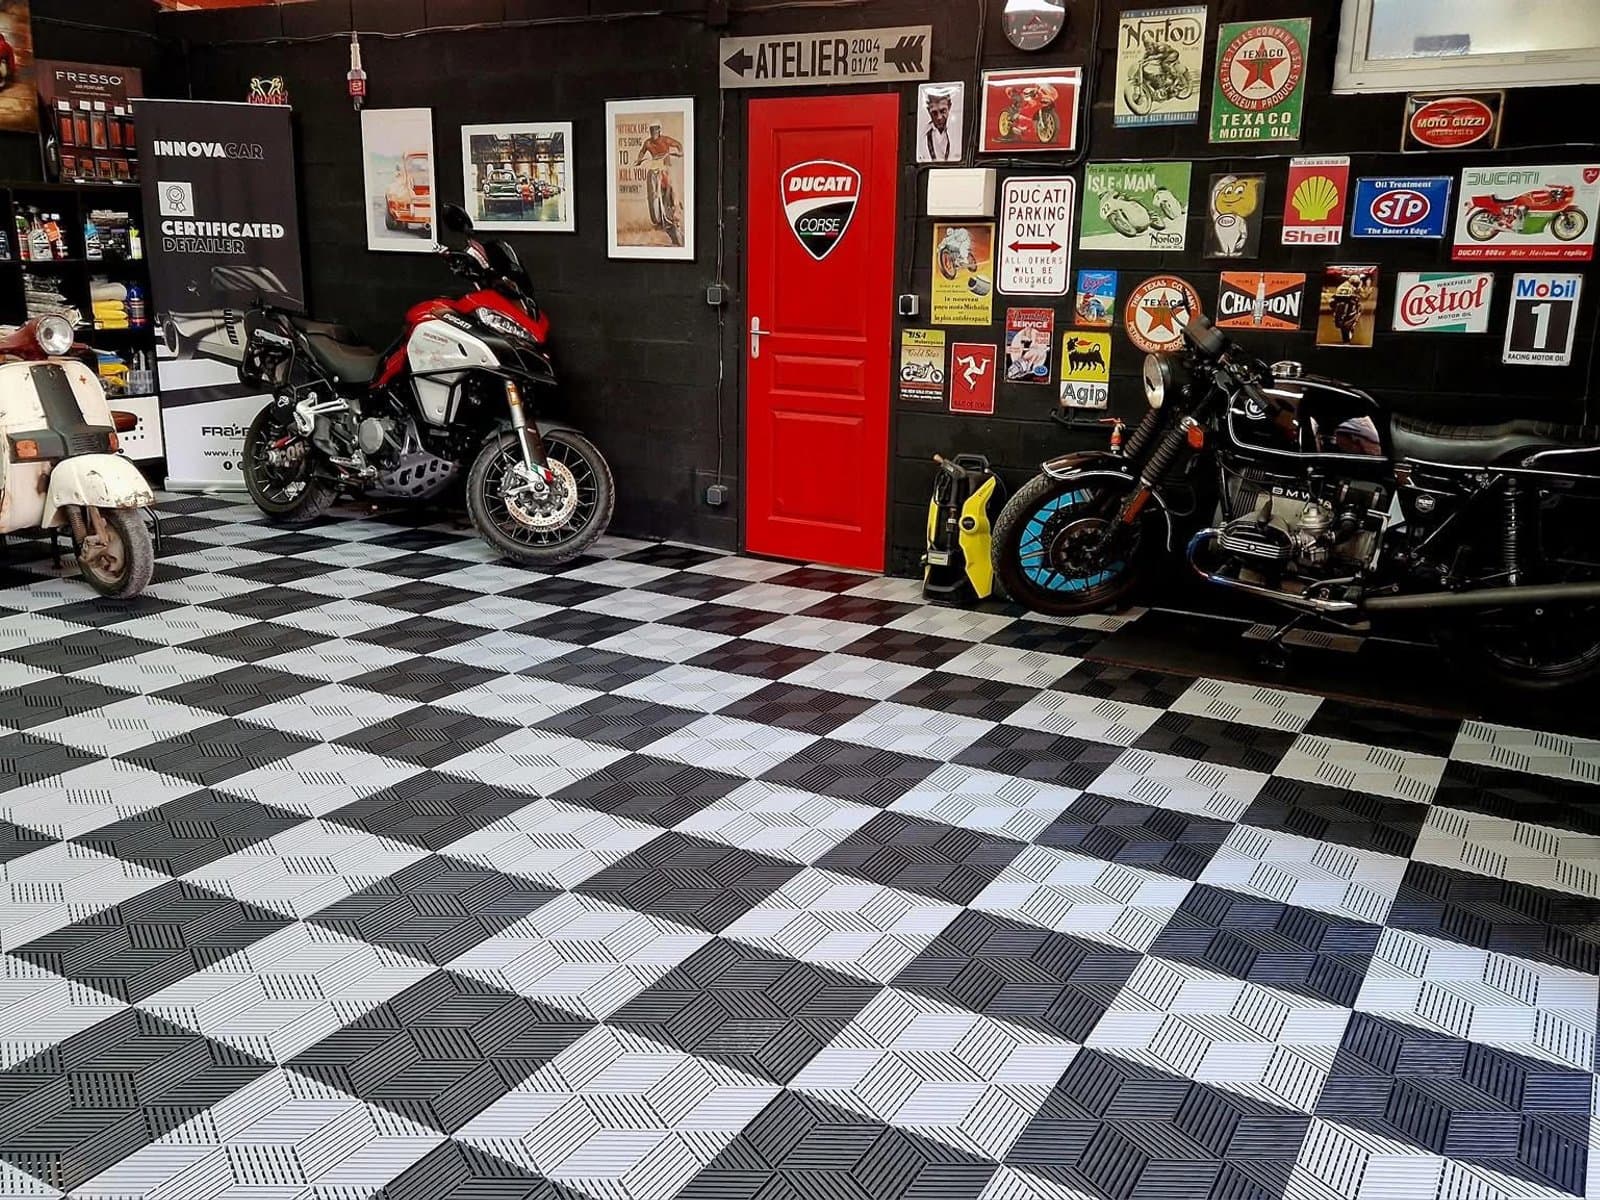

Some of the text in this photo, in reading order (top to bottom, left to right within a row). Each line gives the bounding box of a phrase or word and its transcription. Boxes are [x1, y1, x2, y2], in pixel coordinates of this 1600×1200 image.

[1122, 17, 1202, 49] Norton
[852, 38, 880, 54] 2004
[1243, 48, 1284, 58] TEXACO
[755, 39, 849, 79] ATELIER
[851, 57, 878, 73] 01/12
[56, 71, 122, 85] FRESSO
[1221, 112, 1292, 126] TEXACO
[1417, 117, 1485, 128] MOTO GUZZI
[1219, 127, 1290, 139] MOTOR OIL
[153, 140, 264, 159] INNOVACAR
[619, 150, 628, 165] TO
[634, 168, 647, 181] YOU
[1467, 172, 1540, 185] DUCATI
[789, 176, 852, 192] DUCATI
[1088, 174, 1116, 192] ISLE
[1124, 174, 1156, 193] MAN
[1009, 189, 1066, 204] DUCATI
[1008, 206, 1065, 220] PARKING
[1376, 194, 1423, 220] STP
[161, 220, 285, 238] CERTIFICATED
[800, 218, 840, 232] CORSE
[1016, 223, 1055, 237] ONLY
[1284, 231, 1340, 243] Shell
[163, 237, 246, 254] DETAILER
[1013, 276, 1053, 284] CRUSHED
[1143, 280, 1167, 293] TEXAS
[1517, 279, 1576, 298] Mobil
[1221, 290, 1301, 317] CHAMPION
[1401, 277, 1488, 326] Castrol
[443, 313, 472, 329] DUCATI
[1012, 320, 1049, 329] SERVICE
[1531, 303, 1551, 349] 1
[1508, 353, 1531, 361] RACING
[1532, 353, 1554, 361] MOTOR
[1062, 383, 1107, 406] Agip
